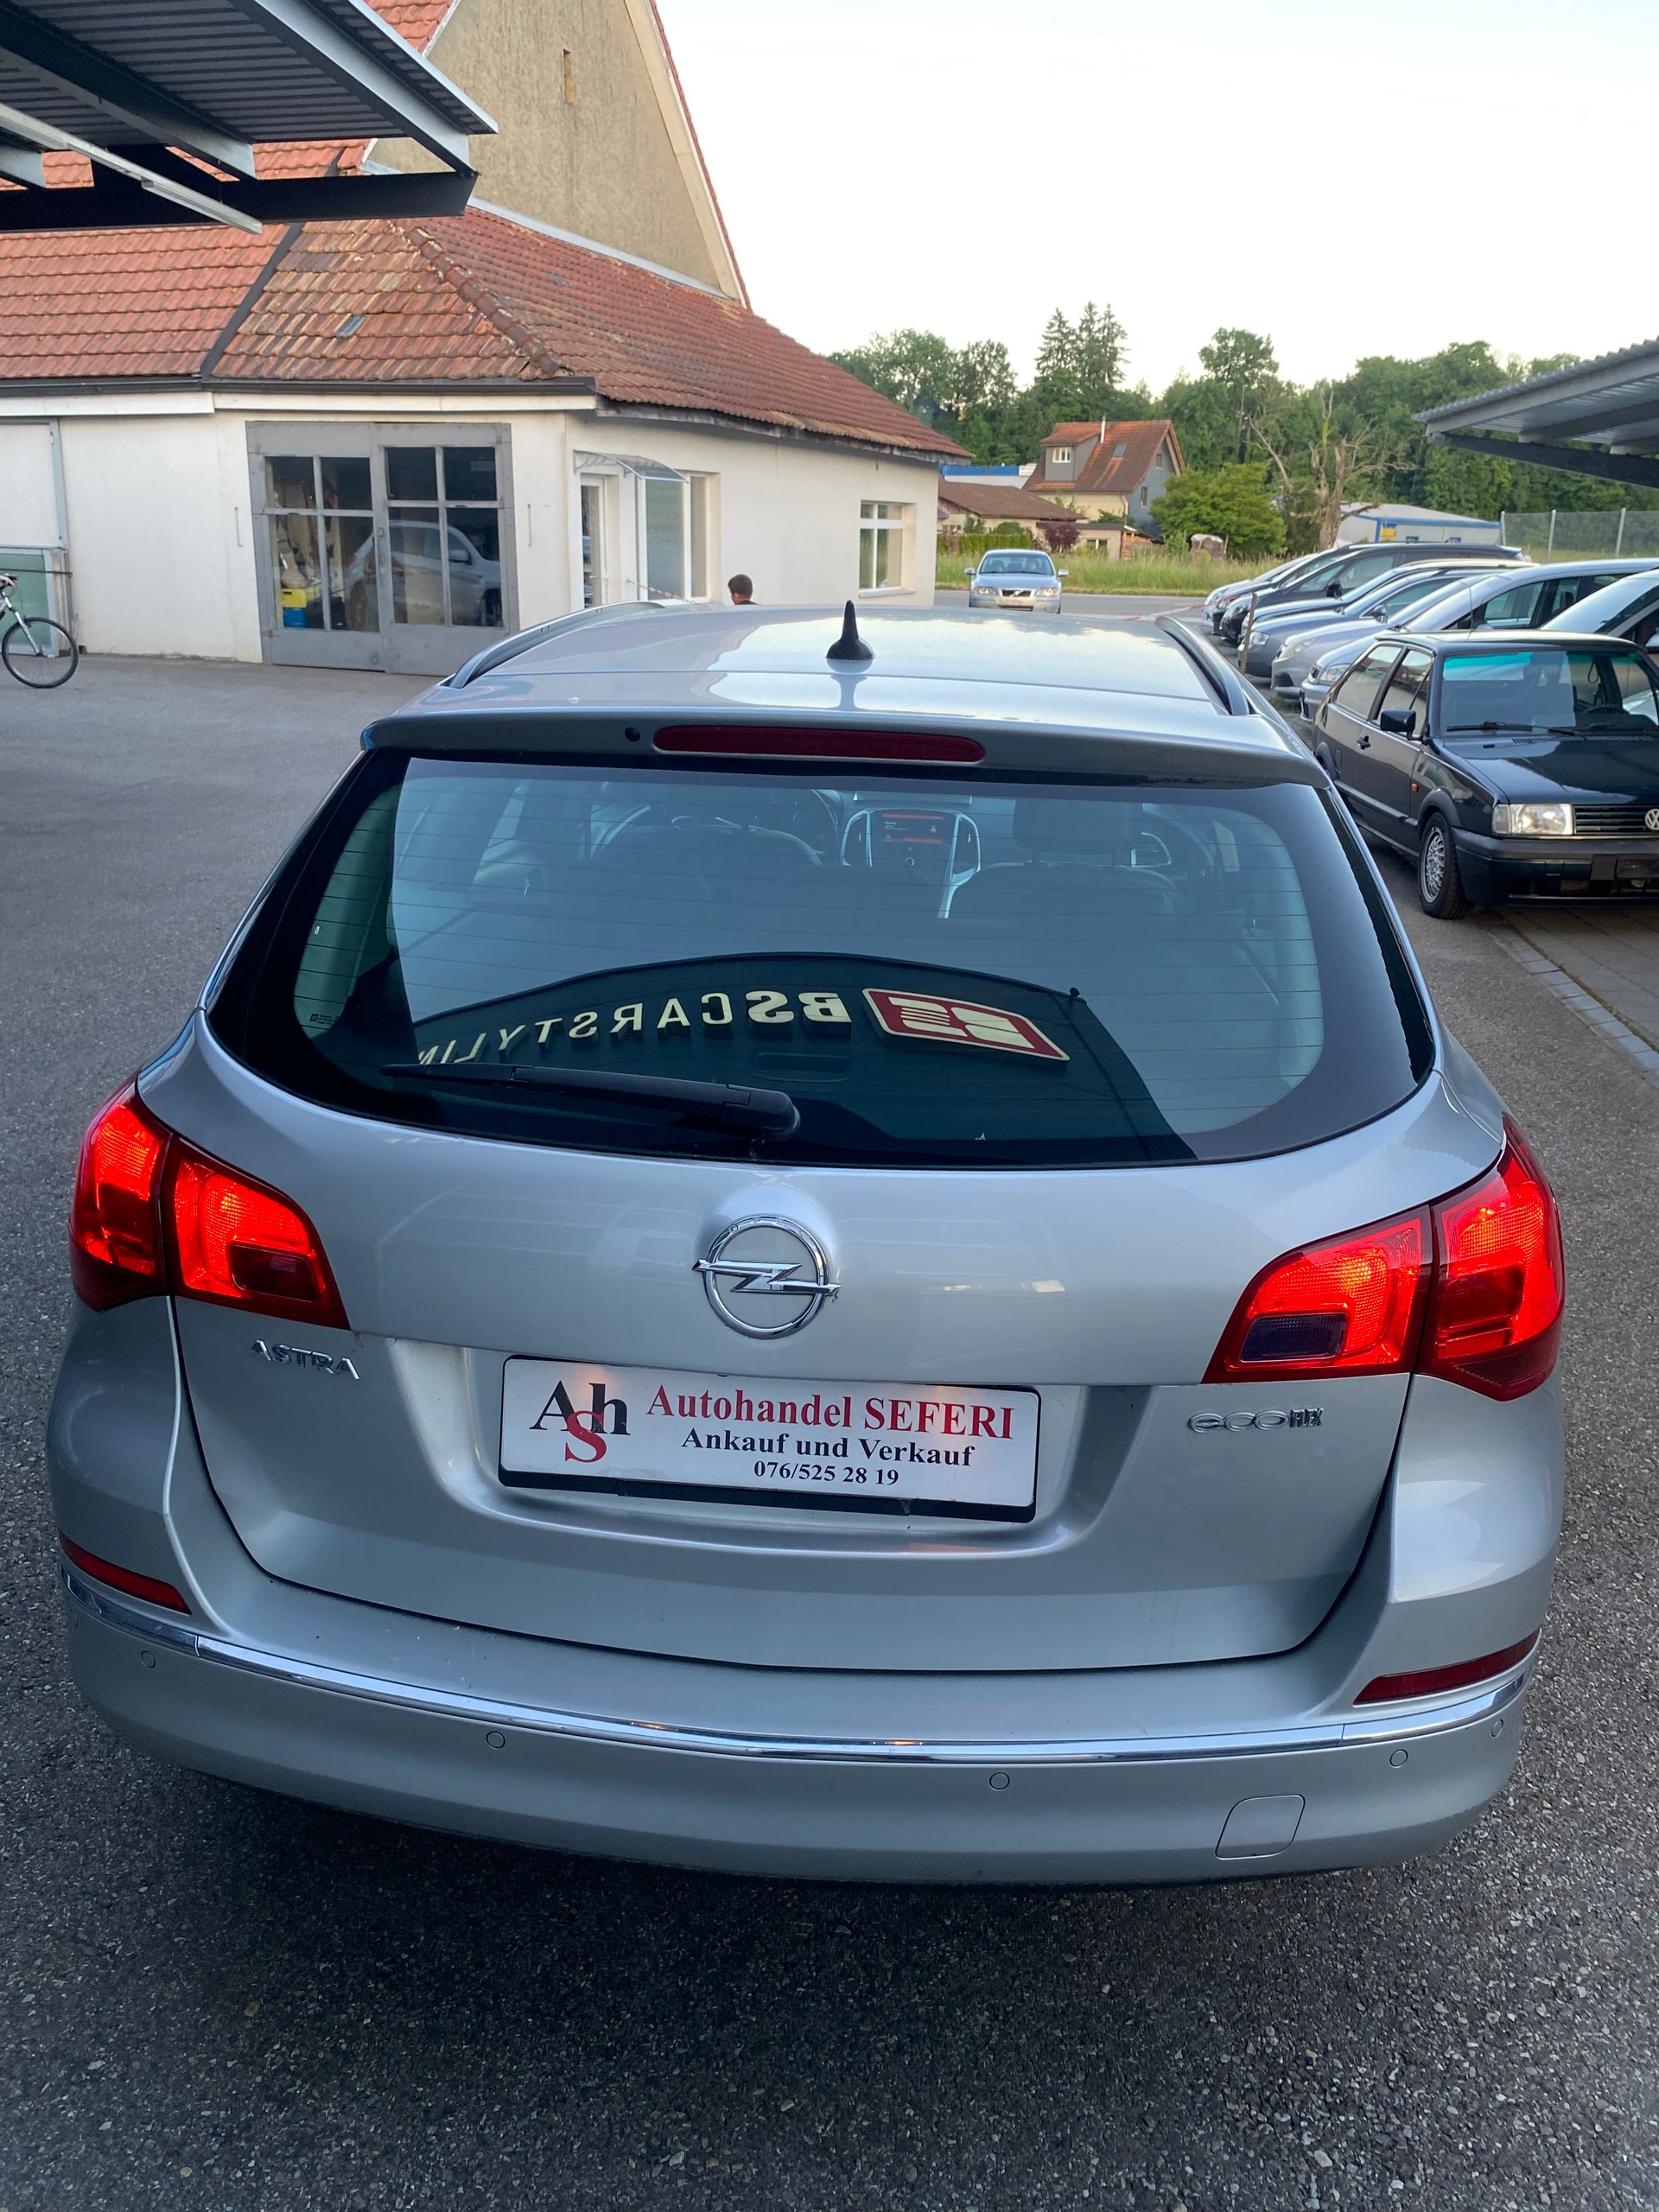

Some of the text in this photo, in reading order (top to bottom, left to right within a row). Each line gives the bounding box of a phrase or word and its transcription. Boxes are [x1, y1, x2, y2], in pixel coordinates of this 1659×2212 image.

[251, 1338, 360, 1380] ASTRA
[645, 1384, 1014, 1440] Autohandel SEFERI
[681, 1427, 976, 1467] Ankauf und Verkauf
[753, 1460, 899, 1486] 076/525 28 19
